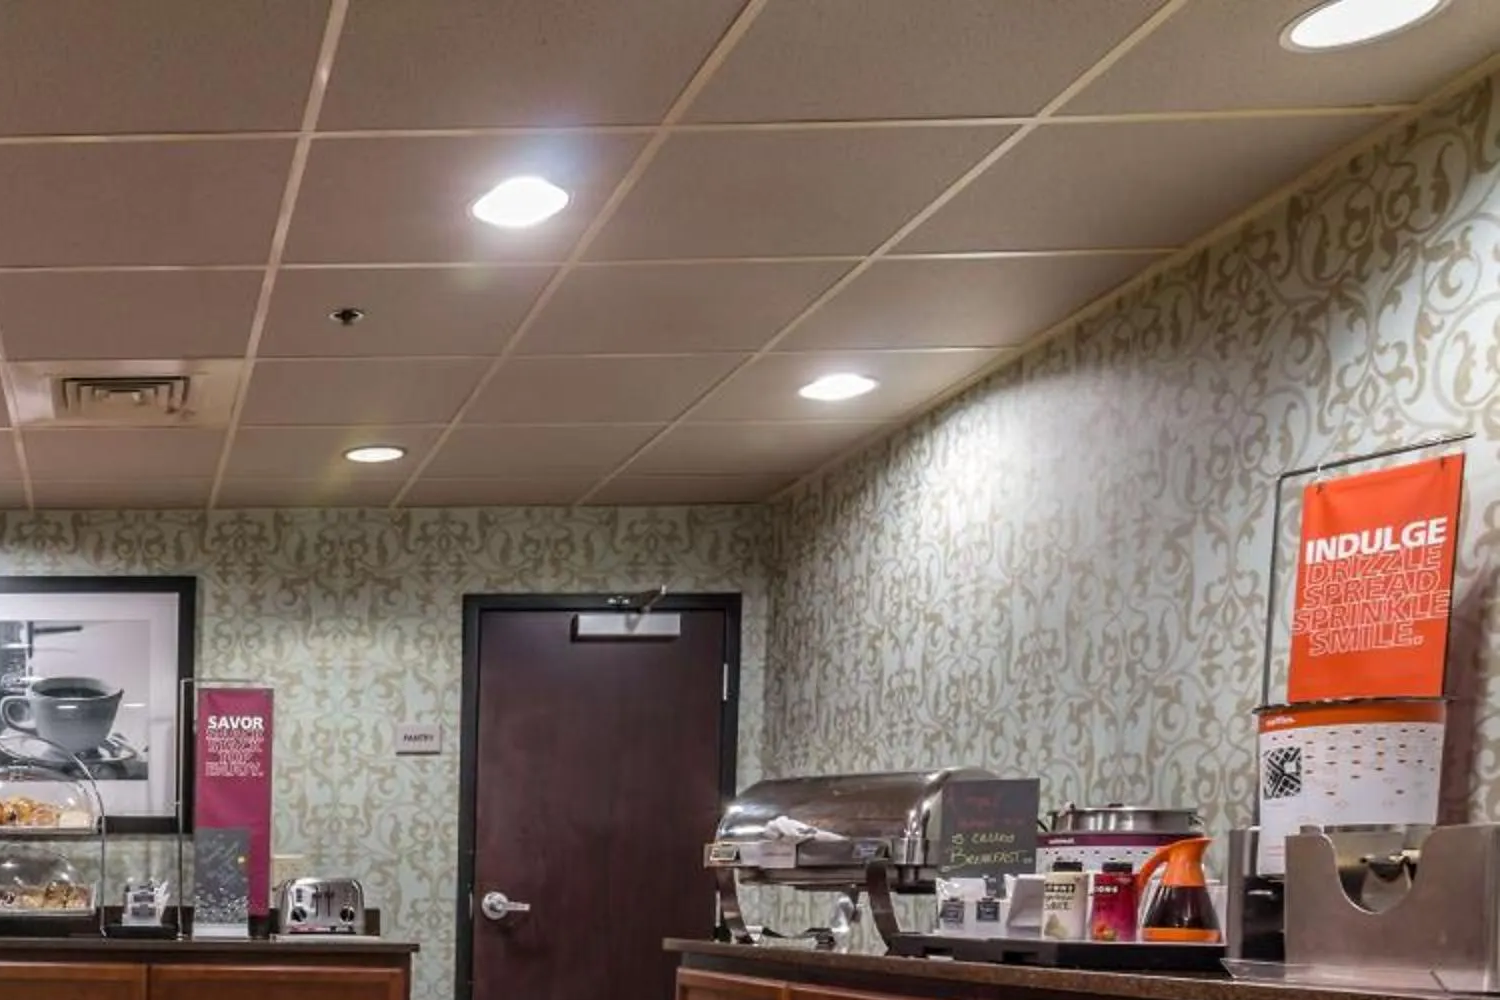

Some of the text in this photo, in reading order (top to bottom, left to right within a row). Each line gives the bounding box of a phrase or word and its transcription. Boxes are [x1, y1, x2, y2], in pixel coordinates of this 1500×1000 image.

[1305, 517, 1449, 565] INDULGE
[1306, 543, 1444, 585] DRIZZLE
[1303, 569, 1441, 611] SPREAD
[1291, 589, 1452, 636] SPRINKLE
[1309, 621, 1424, 657] SMILE.
[207, 715, 264, 730] SAVOR
